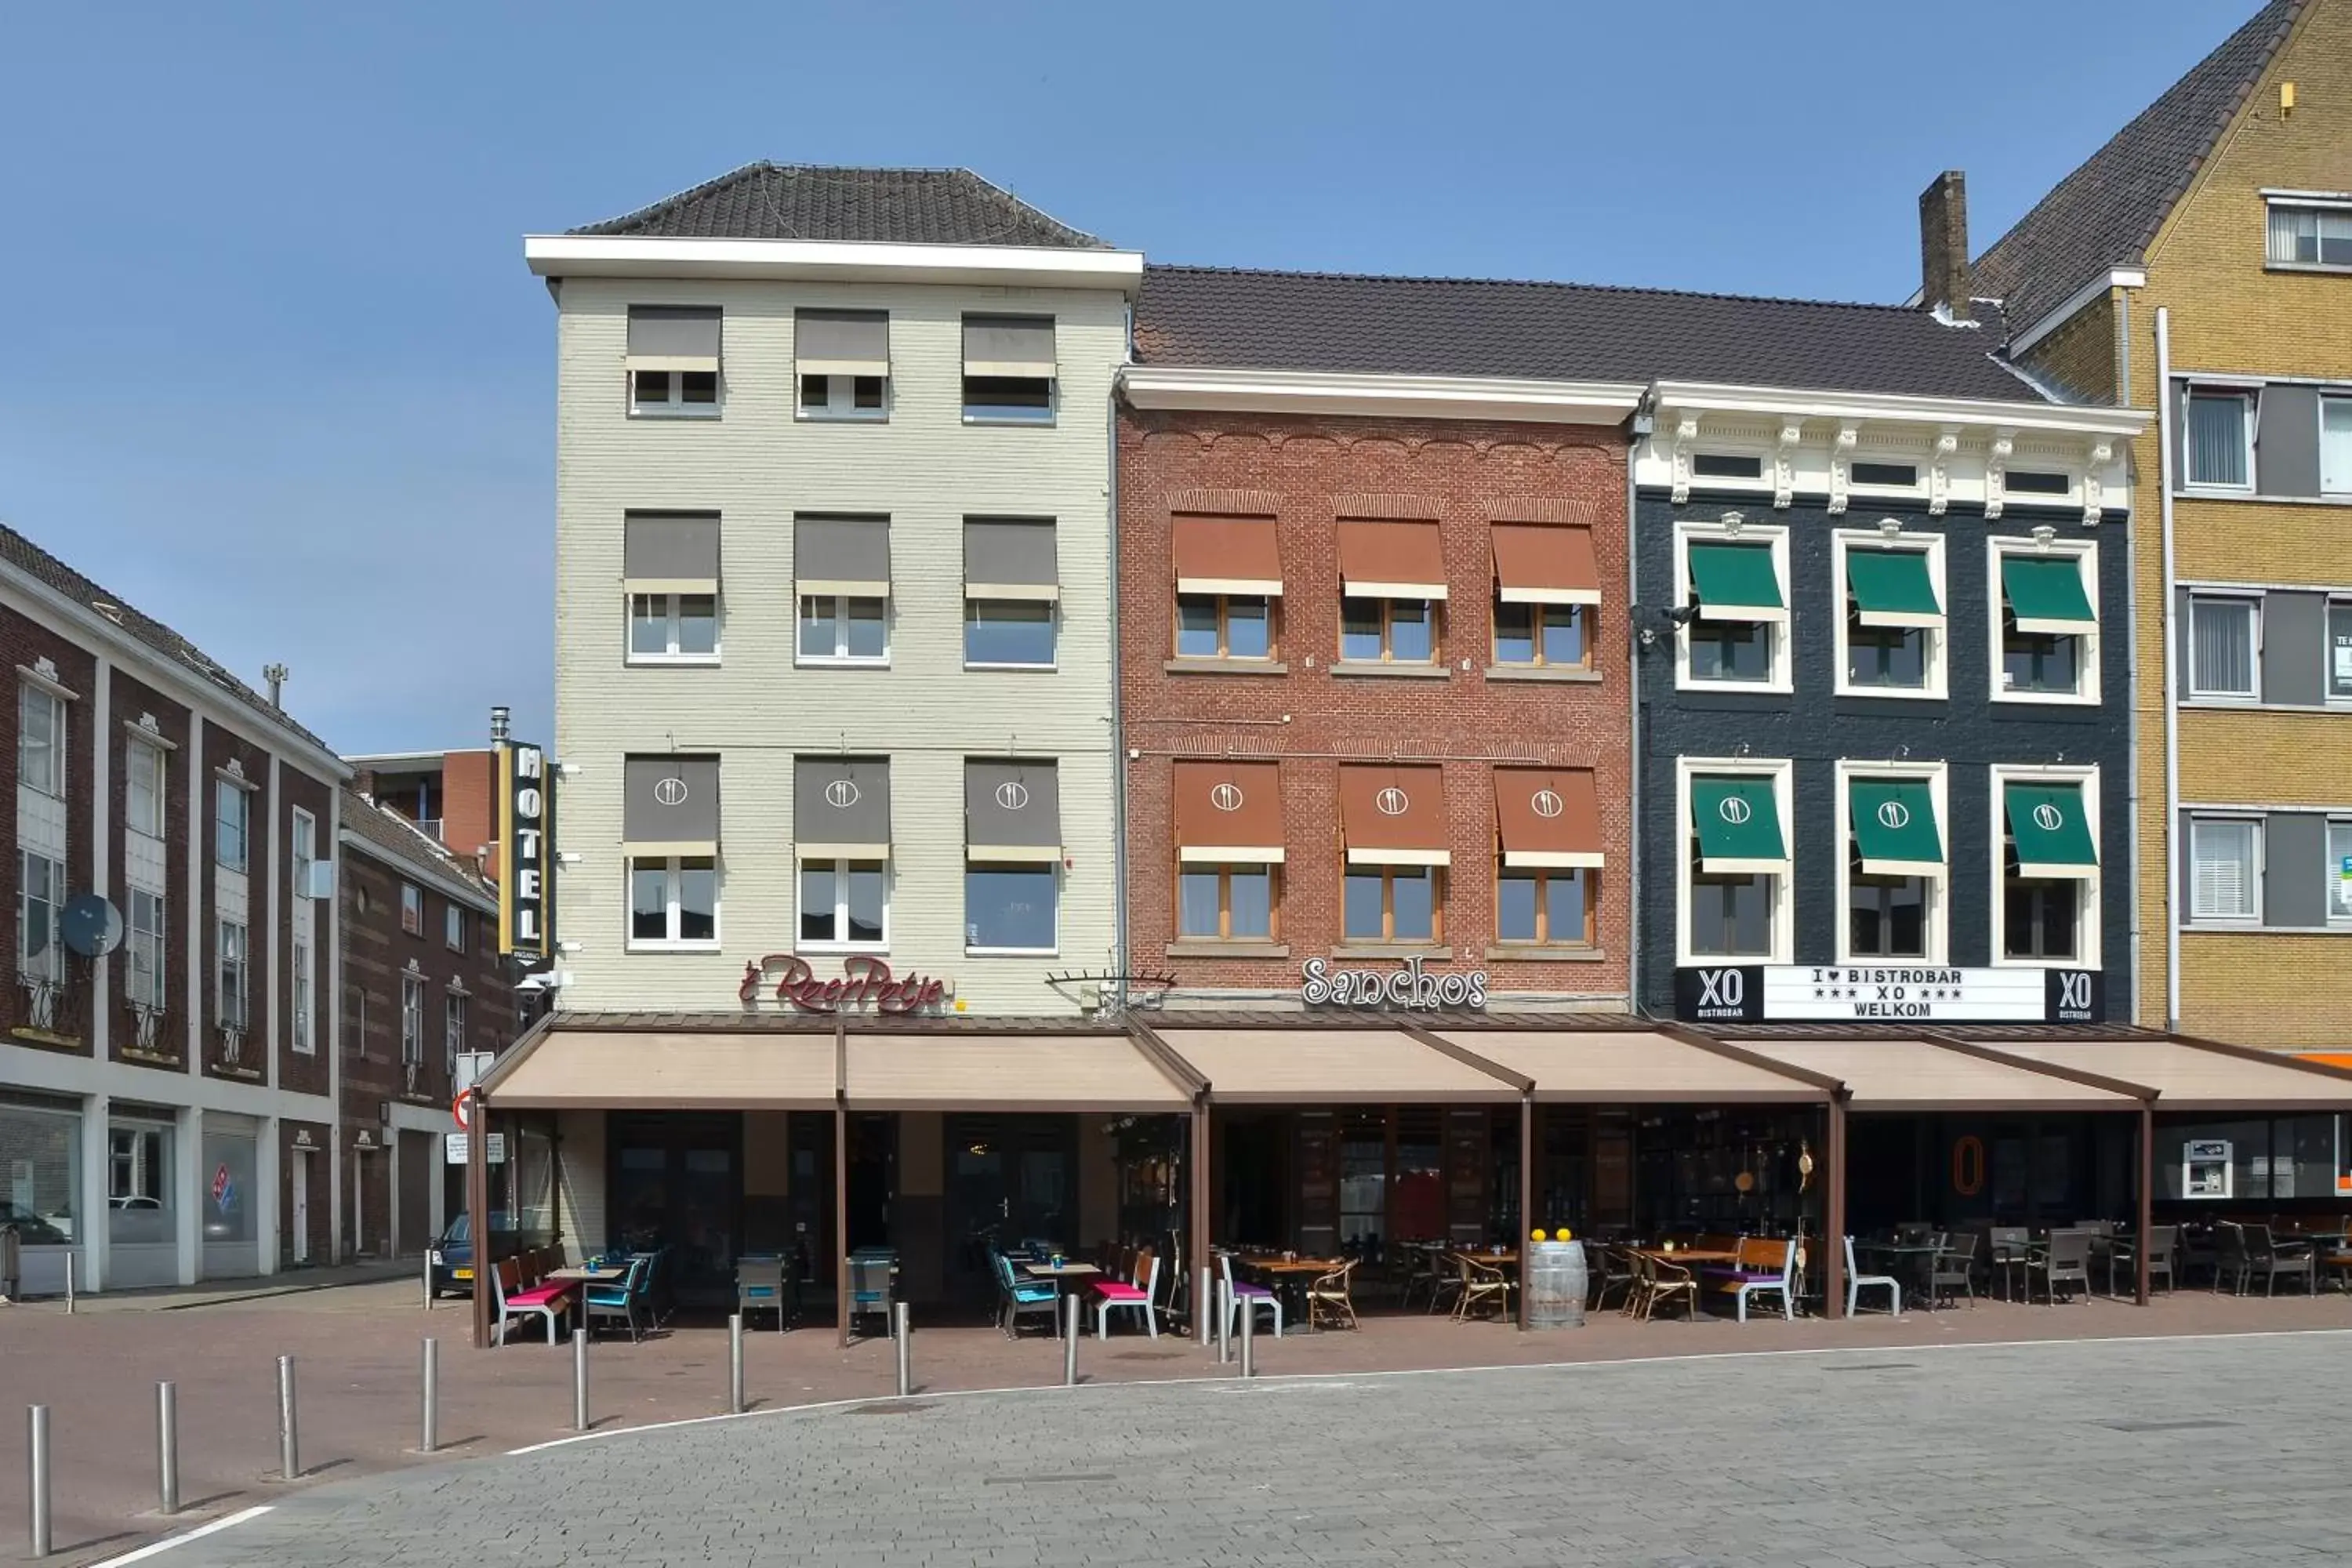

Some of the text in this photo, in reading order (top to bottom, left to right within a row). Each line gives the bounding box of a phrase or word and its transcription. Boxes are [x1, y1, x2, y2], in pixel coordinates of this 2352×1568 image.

[518, 747, 540, 940] HOTEL
[1302, 955, 1487, 1007] Sanchos
[1698, 968, 1743, 1006] XO
[1813, 969, 1962, 983] I BISTROBAR
[1877, 986, 1904, 1000] XO
[2060, 971, 2091, 1009] XO
[1697, 1008, 1743, 1018] BISTROBAR
[1854, 1003, 1931, 1017] WELKOM
